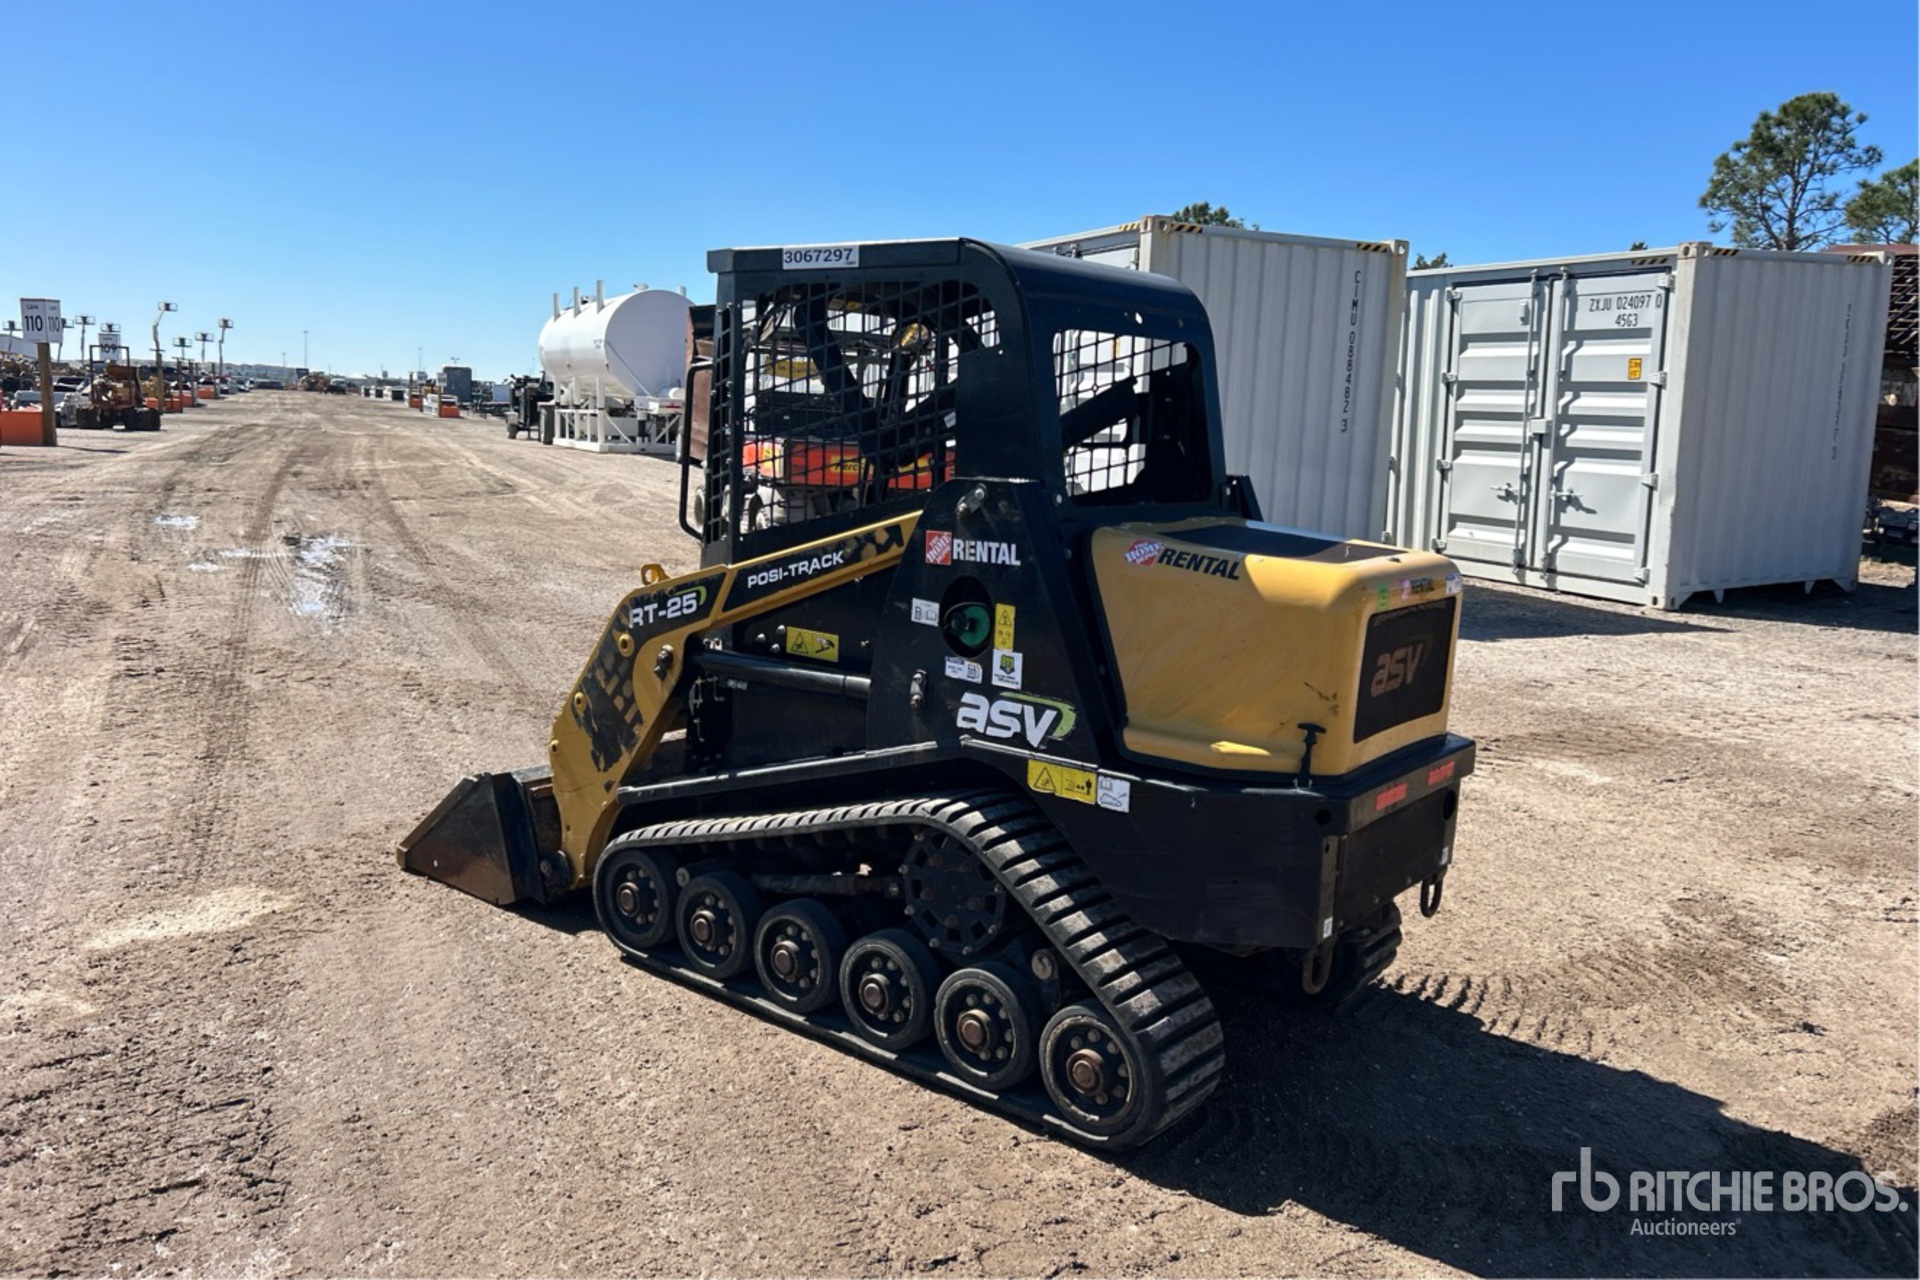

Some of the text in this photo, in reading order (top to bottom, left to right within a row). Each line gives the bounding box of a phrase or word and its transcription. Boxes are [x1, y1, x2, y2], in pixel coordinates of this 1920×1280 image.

[784, 248, 853, 264] 3067297
[1350, 270, 1361, 326] CIMU
[1589, 298, 1612, 312] ZXJU
[1616, 295, 1652, 310] 024097
[24, 315, 43, 332] 110
[47, 316, 60, 332] 110
[1615, 313, 1638, 327] 45G3
[952, 538, 1021, 566] RENTAL
[747, 551, 844, 589] POSI-TRACK
[1158, 548, 1239, 581] RENTAL
[629, 592, 698, 629] RT-25
